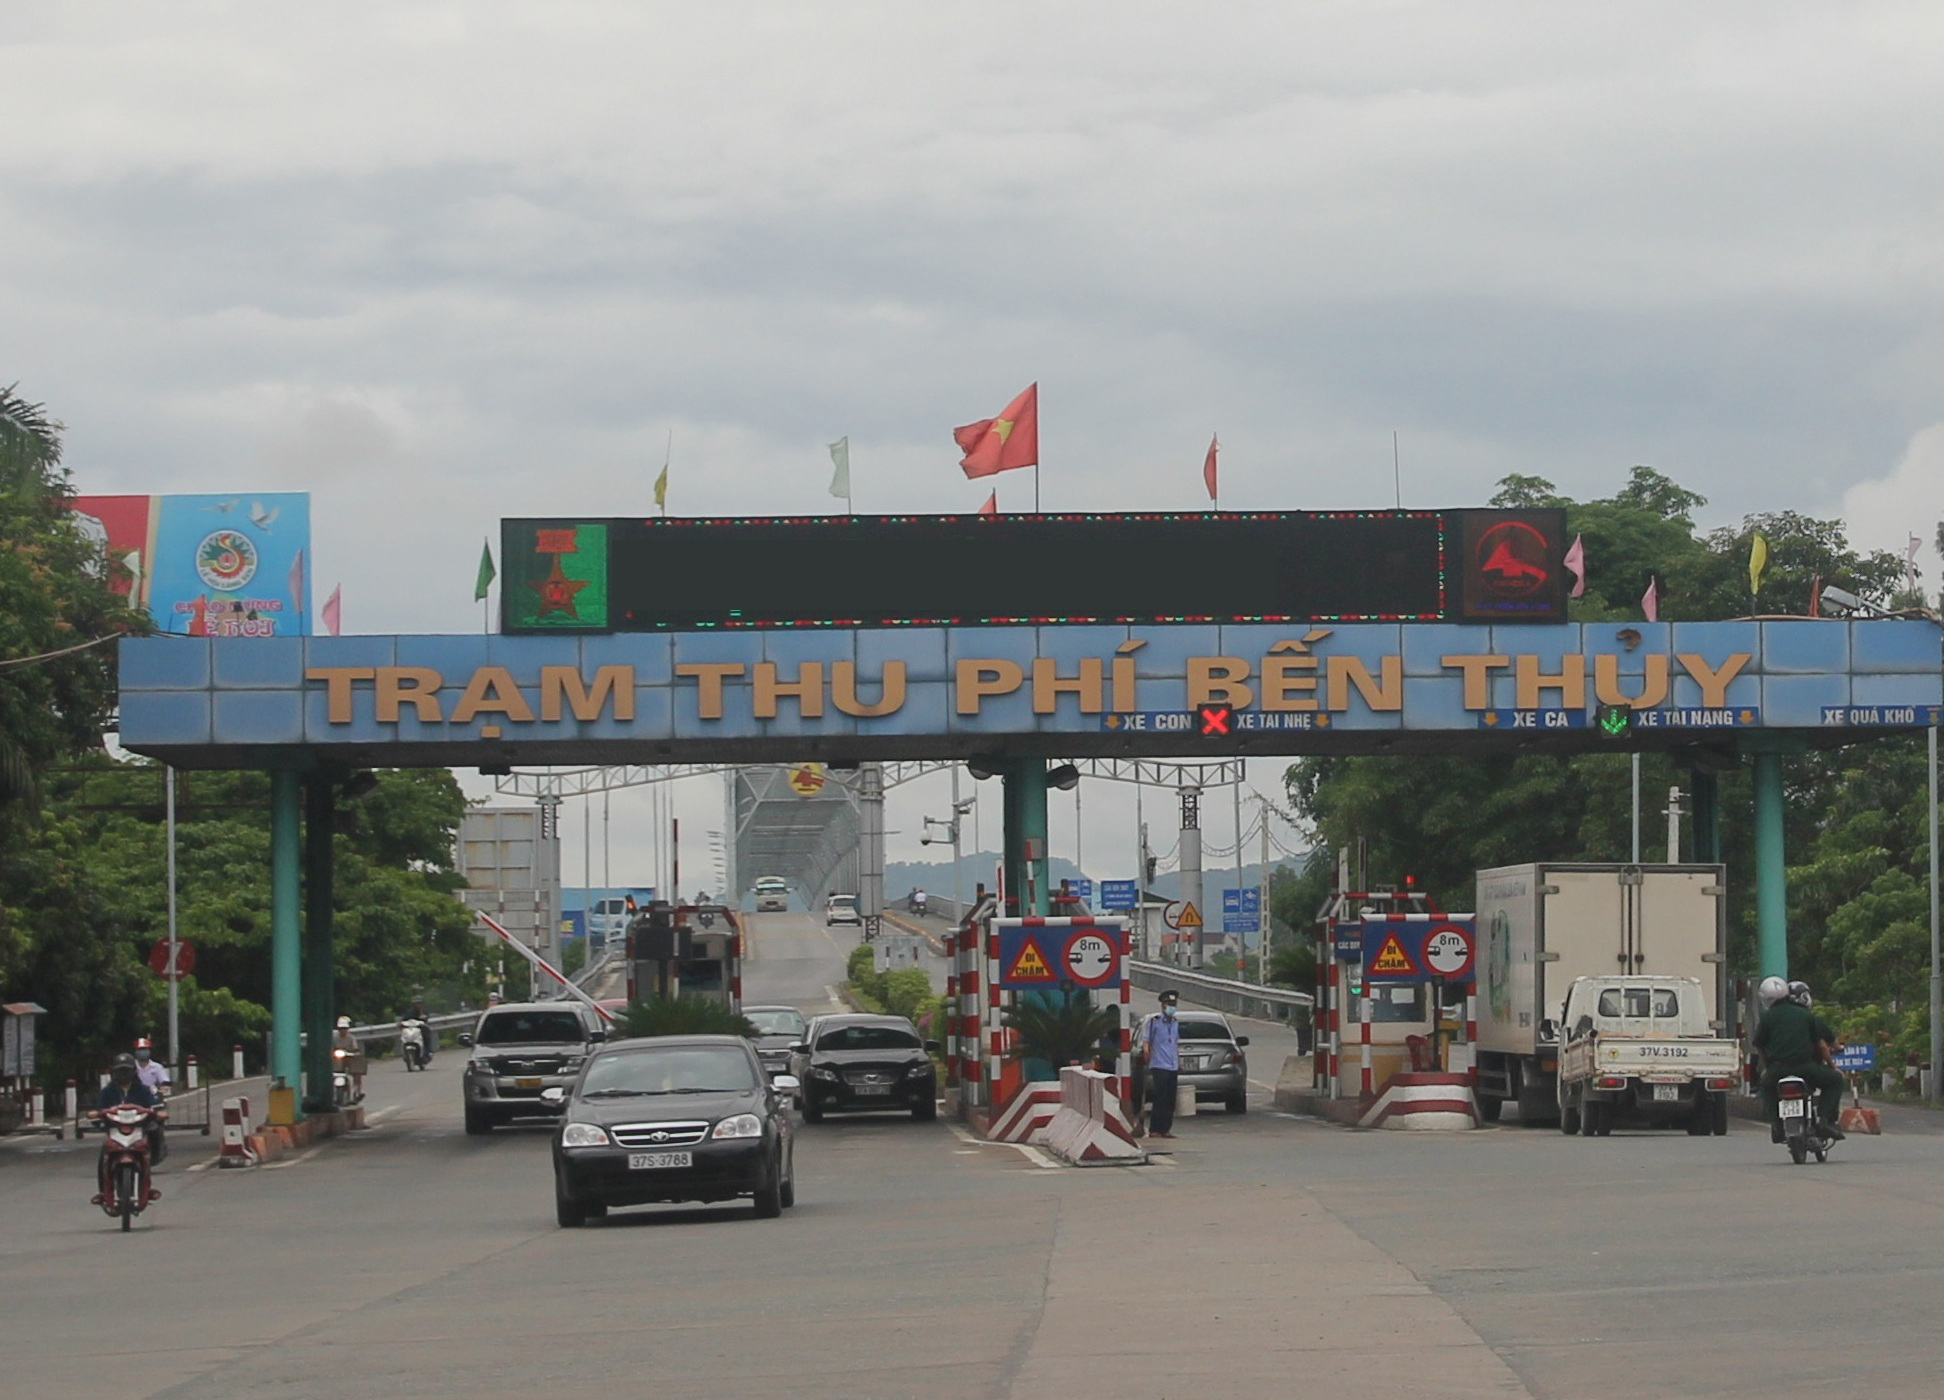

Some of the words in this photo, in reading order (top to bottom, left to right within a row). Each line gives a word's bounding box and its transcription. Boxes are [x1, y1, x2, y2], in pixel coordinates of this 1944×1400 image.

[305, 665, 635, 738] TRẠM
[674, 659, 906, 719] THU
[956, 639, 1148, 714] PHÍ
[1186, 629, 1403, 712] BẾN
[1441, 628, 1752, 710] THỦY
[1124, 714, 1146, 730] XE
[1155, 713, 1192, 730] CON
[1237, 713, 1254, 729] XE
[1284, 712, 1311, 731] NHẸ
[1513, 711, 1536, 728] XE
[1544, 711, 1569, 728] CA
[1638, 710, 1658, 727] XE
[1824, 709, 1844, 725] XE
[1850, 706, 1880, 726] QUÁ
[1080, 939, 1100, 951] 8m
[1440, 934, 1460, 946] 8m
[1639, 1047, 1688, 1057] 37V.3192
[633, 1153, 689, 1168] 37S-3788
